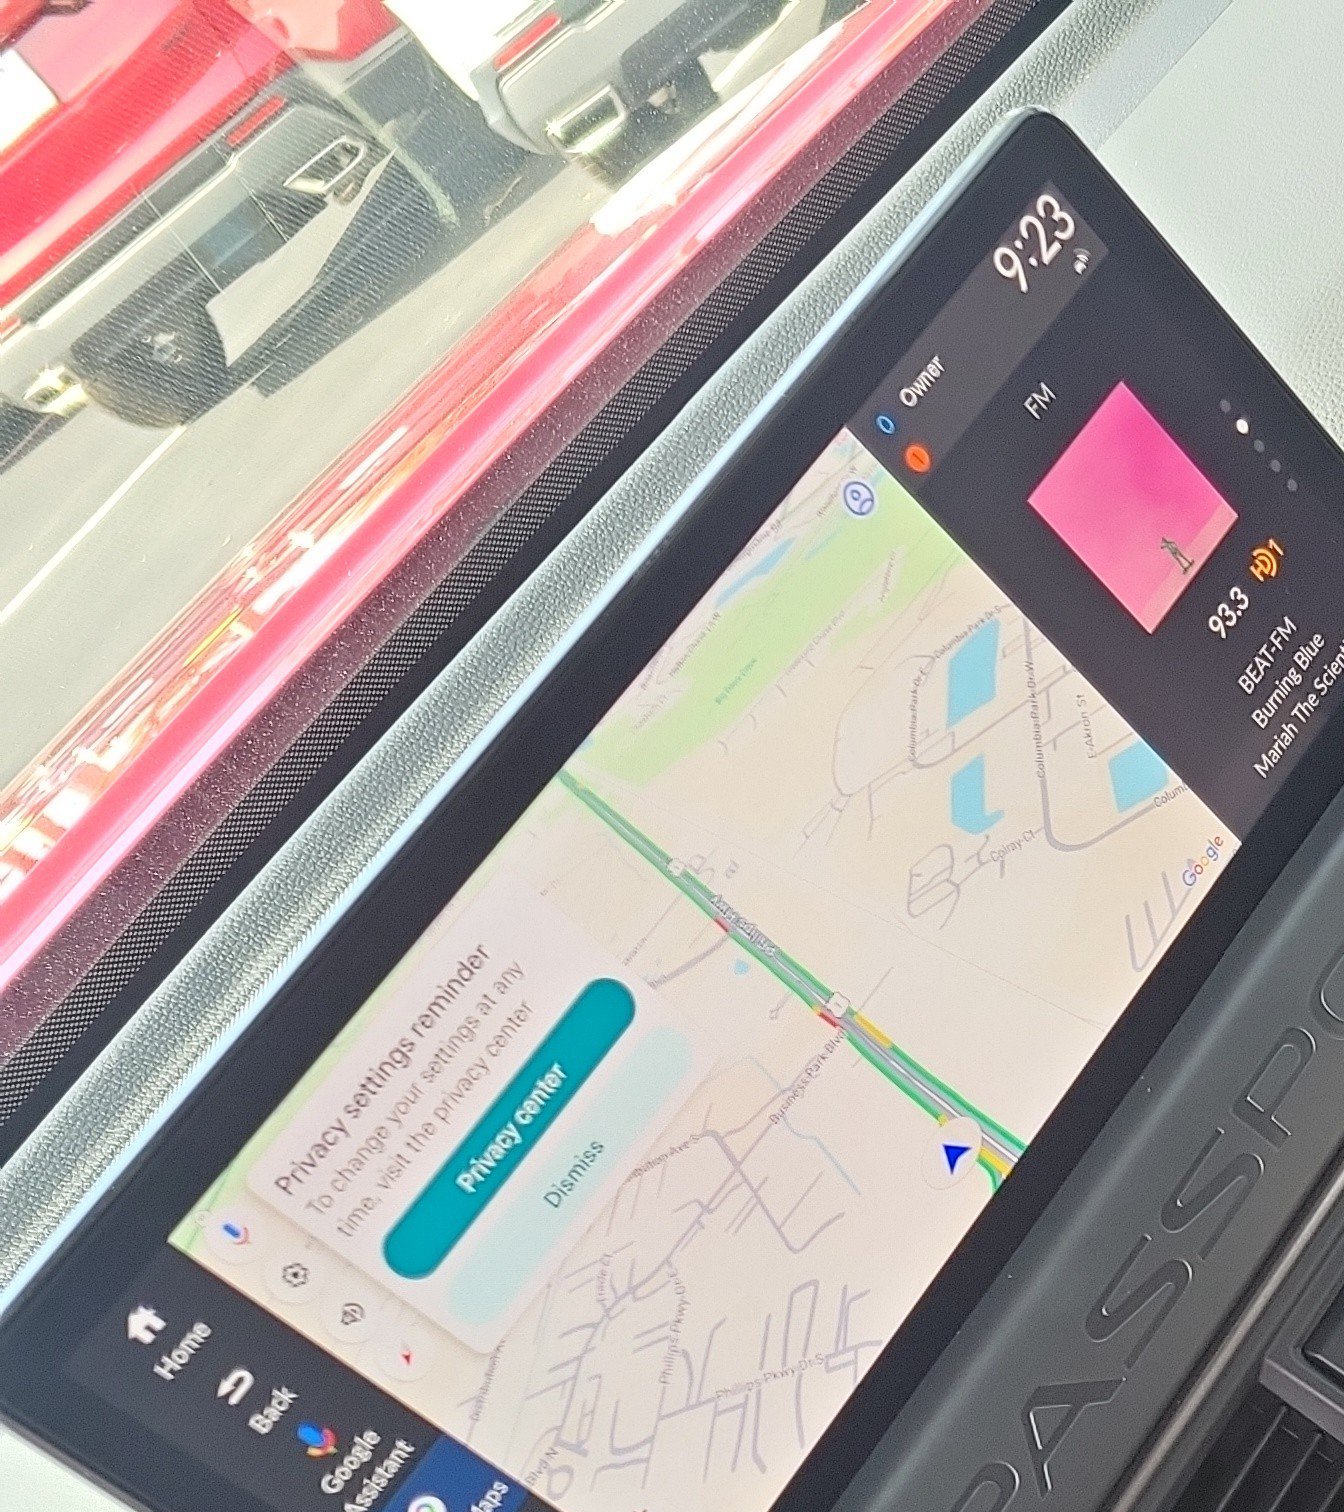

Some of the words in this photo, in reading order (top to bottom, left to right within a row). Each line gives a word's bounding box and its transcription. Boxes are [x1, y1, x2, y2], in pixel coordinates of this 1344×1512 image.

[992, 194, 1076, 294] 9:23
[899, 354, 946, 408] Owner
[1023, 381, 1057, 420] FM
[1208, 586, 1250, 639] 93.3
[1238, 616, 1299, 695] BEAT-FM
[1251, 663, 1303, 729] Burning
[1294, 631, 1326, 672] Blue
[1254, 722, 1300, 779] Mariah
[1291, 690, 1320, 725] The
[1182, 835, 1224, 887] Google
[274, 1118, 350, 1196] Privacy
[344, 1037, 415, 1119] settings
[411, 944, 491, 1039] reminder
[306, 1193, 334, 1215] To
[331, 1124, 389, 1193] change
[387, 1084, 425, 1129] your
[420, 1013, 481, 1084] settings
[479, 995, 498, 1016] at
[493, 961, 525, 996] any
[337, 1195, 383, 1238] time,
[377, 1154, 412, 1190] visit
[406, 1121, 437, 1154] the
[434, 1060, 491, 1125] privacy
[486, 1000, 534, 1058] center
[455, 1121, 522, 1194] Privacy
[515, 1062, 568, 1125] center
[543, 1140, 605, 1209] Dismiss
[154, 1322, 213, 1381] Home
[248, 1385, 299, 1436] Back
[320, 1428, 381, 1496] Google
